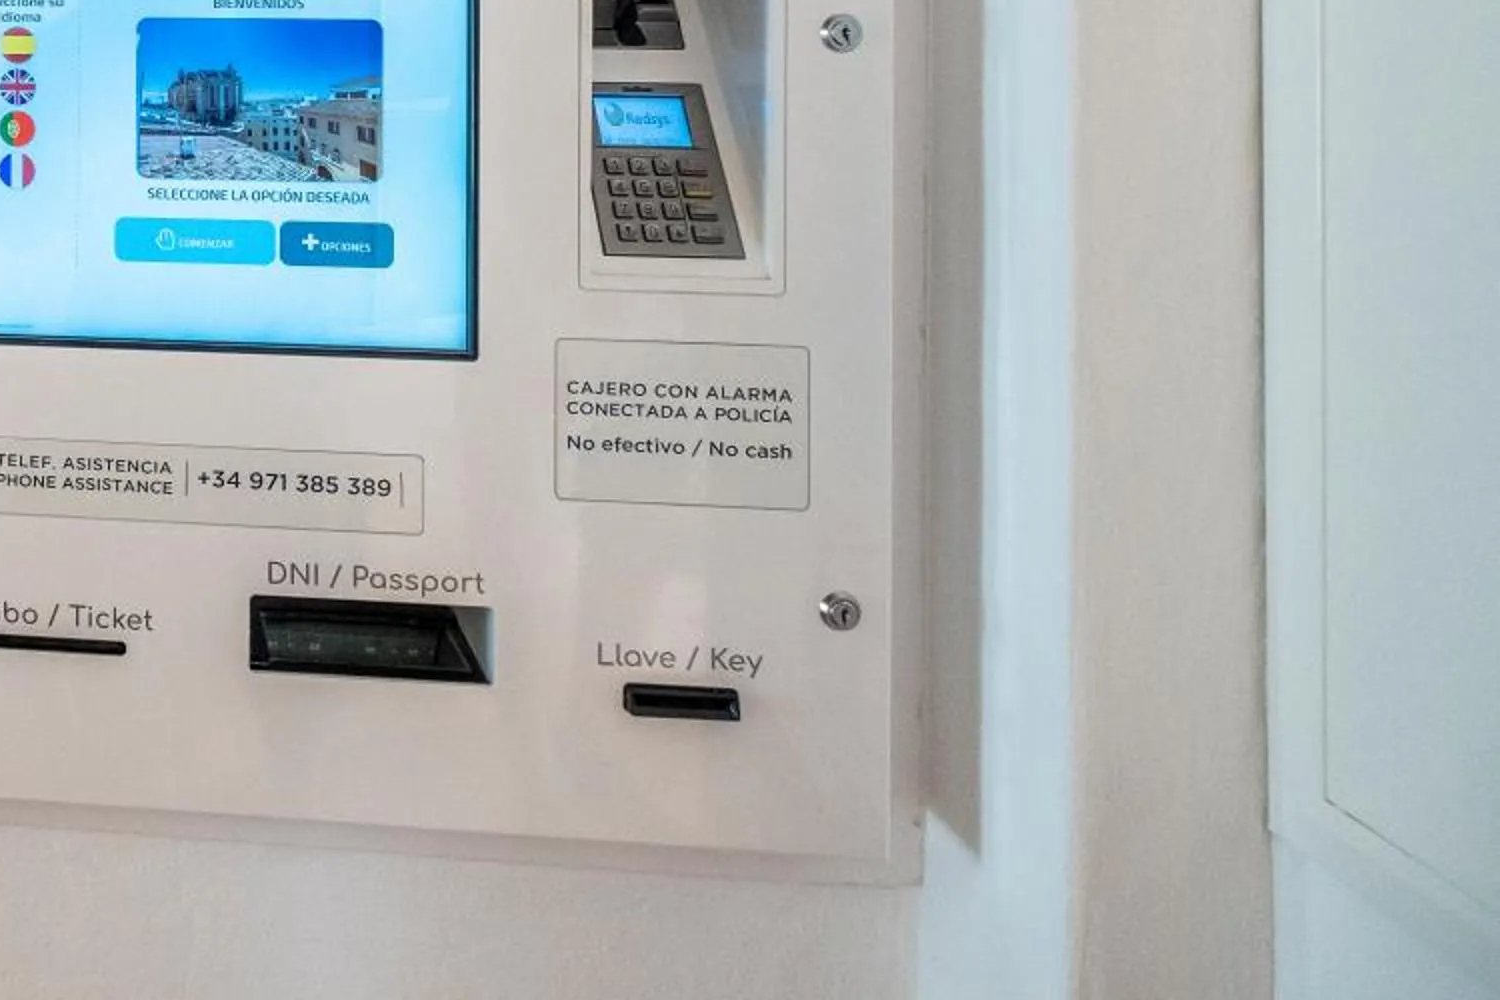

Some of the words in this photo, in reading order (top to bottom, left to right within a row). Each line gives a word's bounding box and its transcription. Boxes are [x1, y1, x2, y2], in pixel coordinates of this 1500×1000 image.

[47, 0, 65, 8] su
[147, 186, 229, 202] SELECCIONE
[230, 189, 249, 202] LA
[250, 187, 304, 204] OPCIÓN
[305, 191, 371, 205] DESEADA
[566, 379, 648, 397] CAJERO
[653, 383, 699, 399] CON
[705, 385, 793, 404] ALARMA
[566, 400, 689, 420] CONECTADA
[693, 406, 709, 421] A
[714, 405, 793, 424] POLICÍA
[566, 434, 596, 452] No
[601, 436, 686, 455] efectivo
[691, 439, 703, 458] /
[709, 440, 739, 457] No
[744, 443, 793, 460] cash
[62, 456, 173, 475] ASISTENCIA
[61, 476, 174, 496] ASSISTANCE
[197, 469, 242, 489] +34
[249, 471, 287, 492] 971
[295, 473, 339, 495] 385
[347, 477, 392, 498] 389
[267, 560, 319, 587] DNI
[328, 563, 343, 589] /
[352, 564, 485, 597] Passport
[47, 603, 60, 629] /
[68, 603, 154, 632] Ticket
[596, 641, 677, 669] Llave
[685, 645, 700, 672] /
[710, 647, 763, 680] Key
